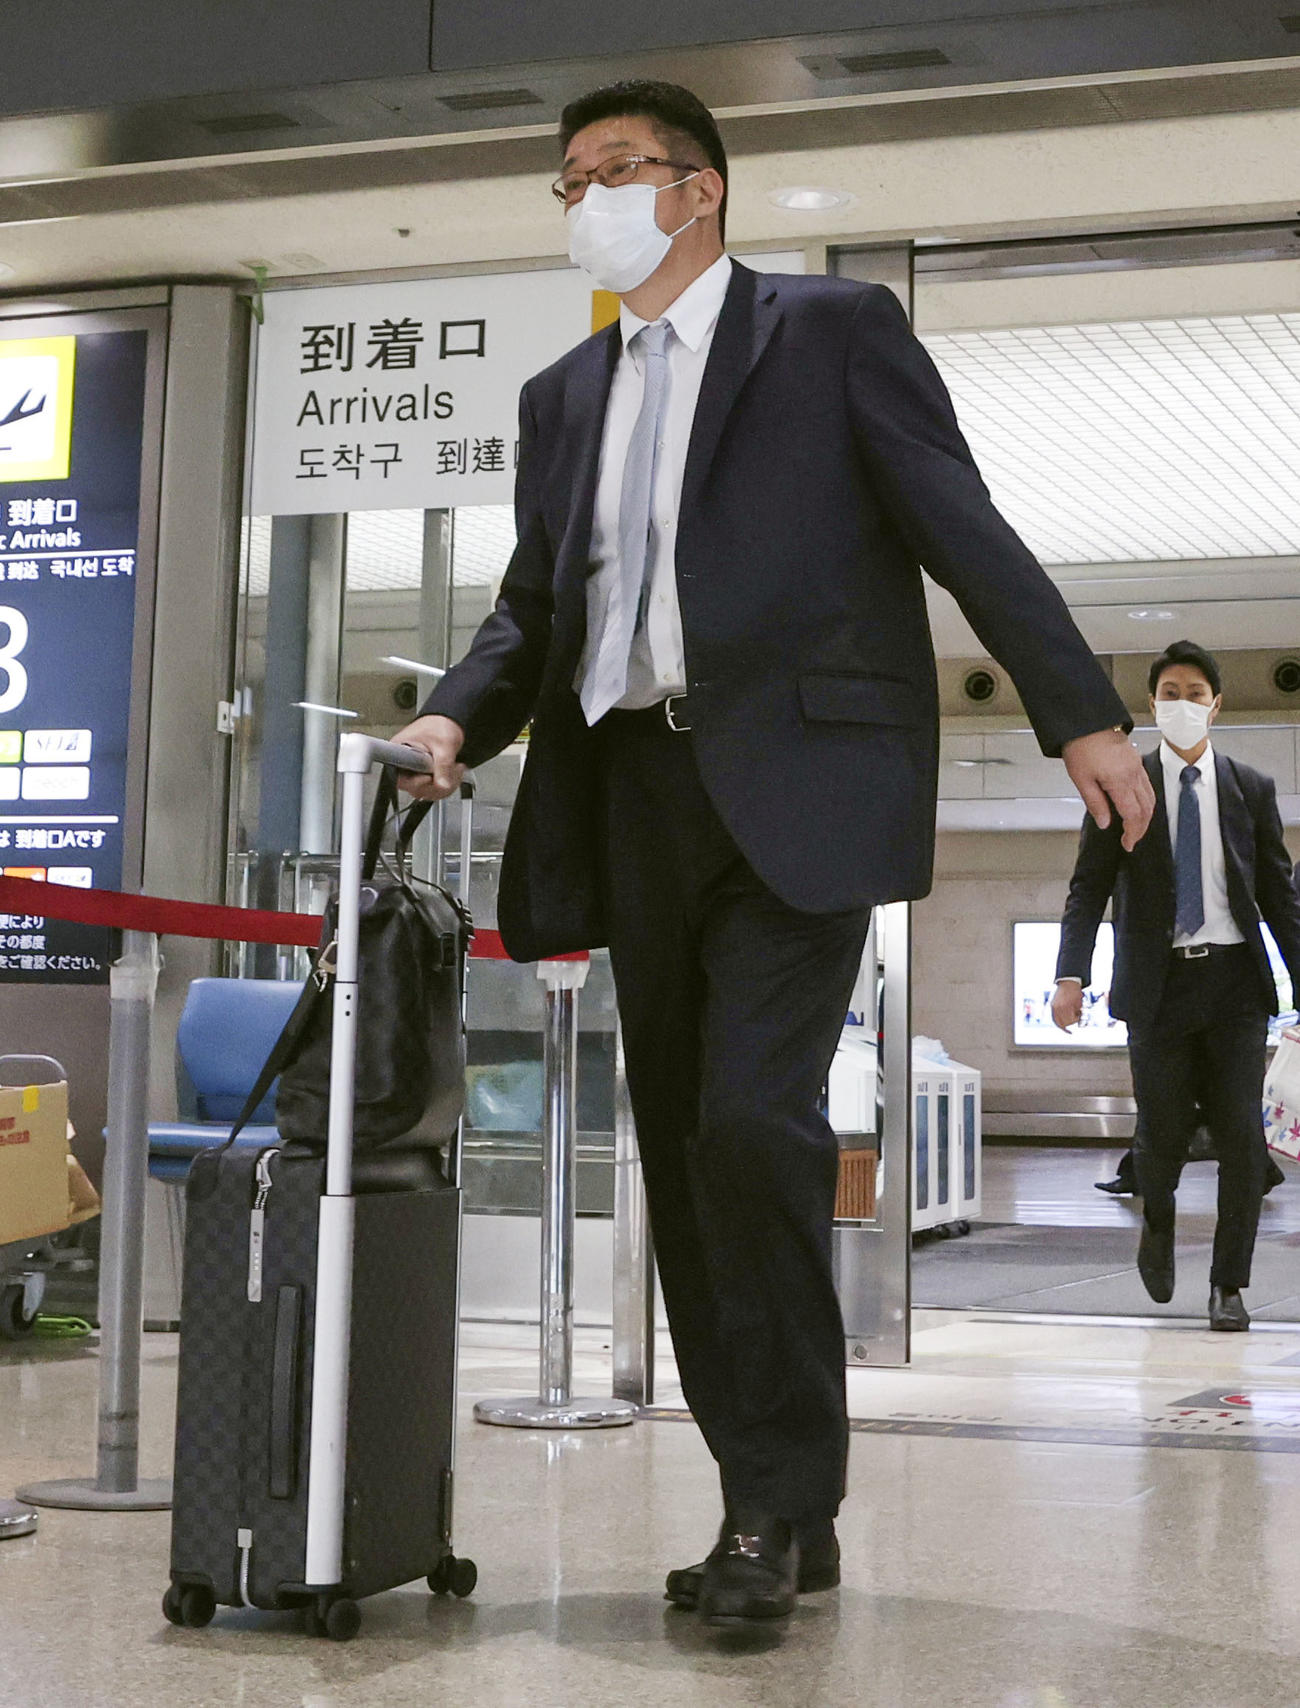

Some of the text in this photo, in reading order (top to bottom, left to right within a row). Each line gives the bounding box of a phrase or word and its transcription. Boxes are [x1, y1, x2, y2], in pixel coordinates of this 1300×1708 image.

[300, 317, 486, 374] 到着口
[296, 383, 454, 426] Arrivals
[296, 442, 402, 480] 도착구
[436, 436, 519, 475] 到達
[7, 498, 78, 526] 到着口
[9, 527, 82, 549] Arrivals
[49, 556, 135, 578] 국내선 도착
